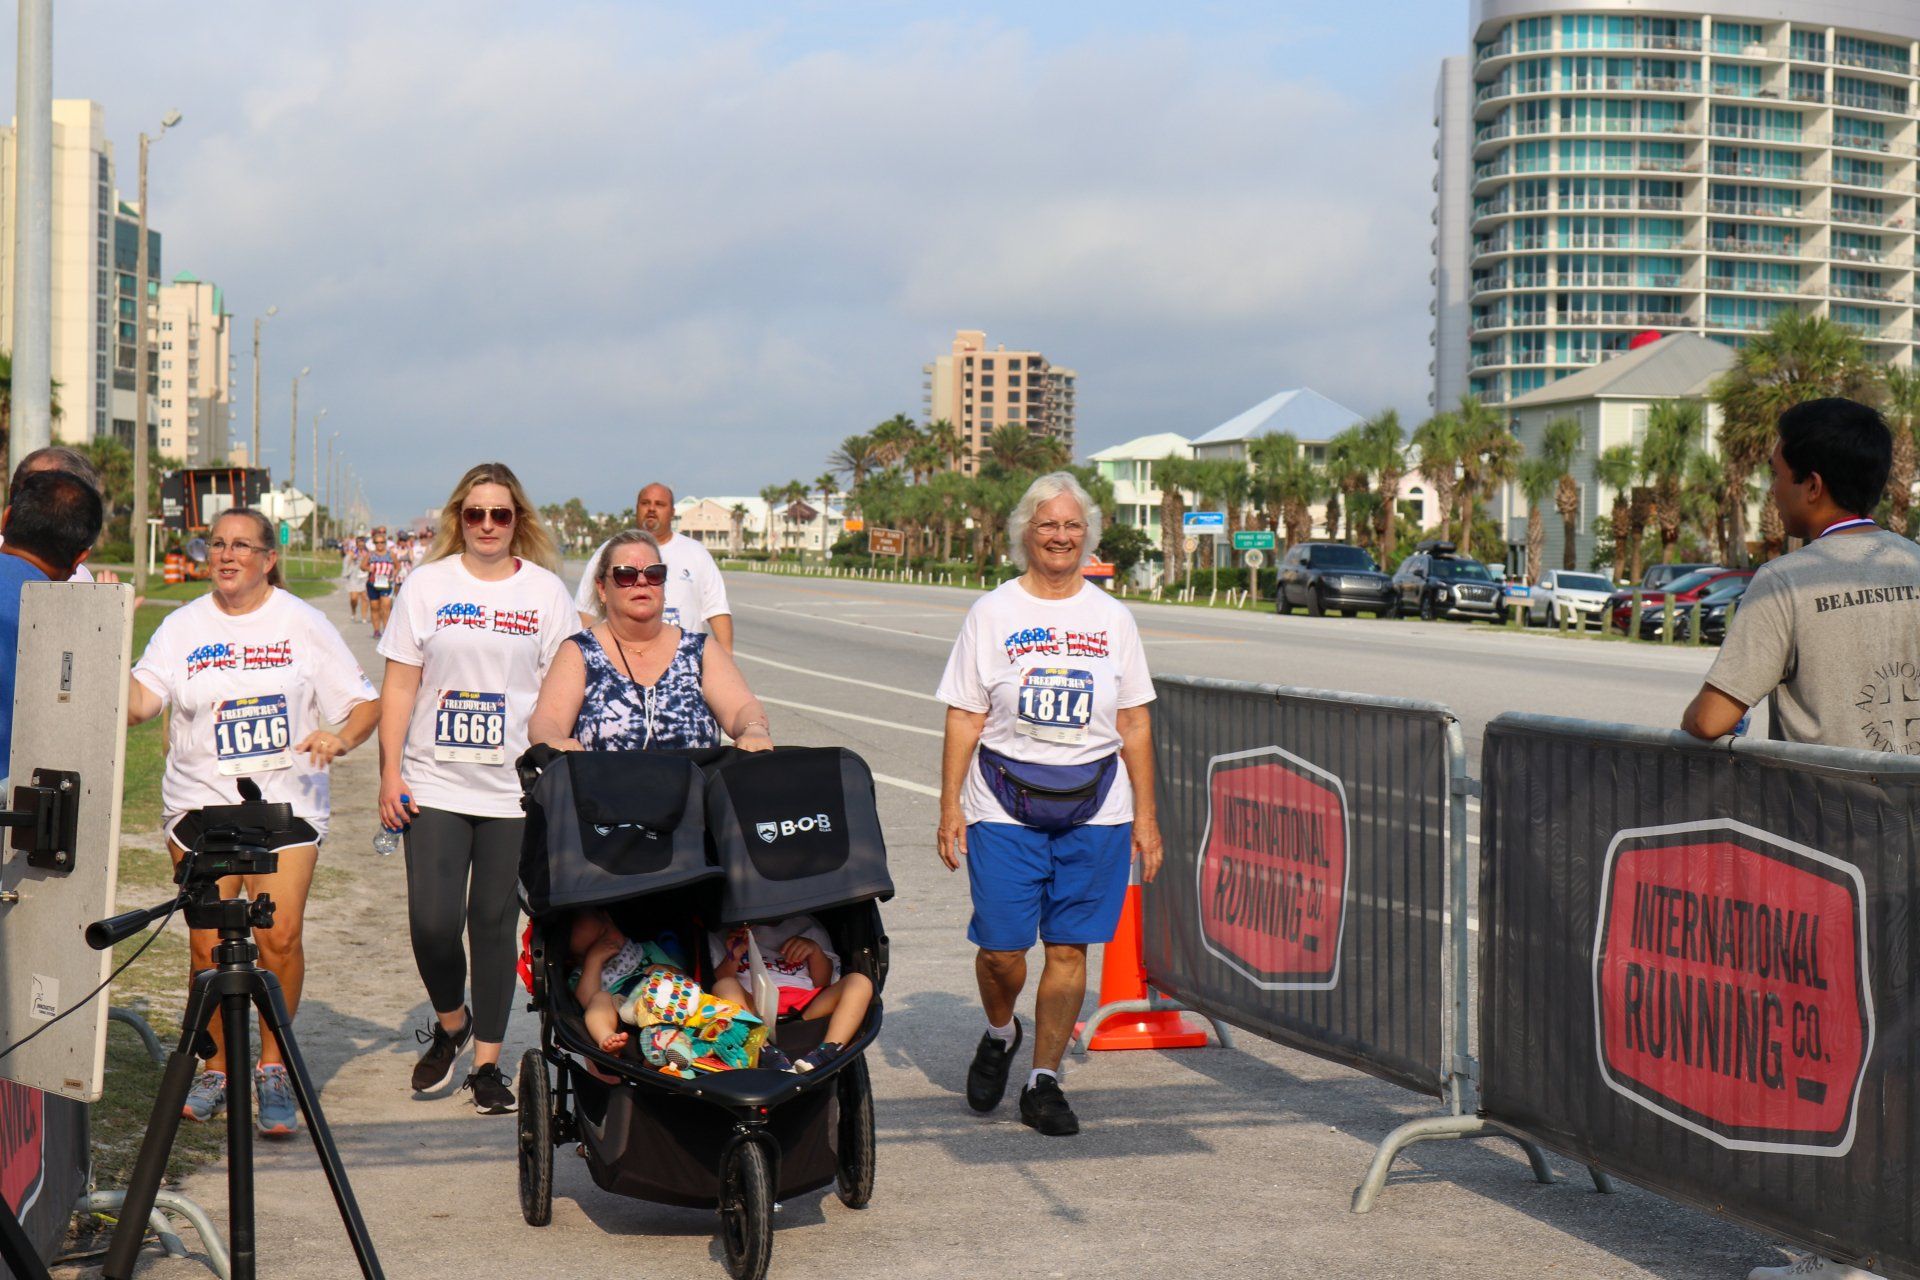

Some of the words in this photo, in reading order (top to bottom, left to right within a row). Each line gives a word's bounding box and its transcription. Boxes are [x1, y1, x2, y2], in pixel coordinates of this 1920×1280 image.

[217, 716, 288, 756] 1646
[438, 712, 503, 745] 1668
[1022, 687, 1090, 724] 1814
[1223, 795, 1330, 869] INTERNATIONAL
[1213, 855, 1304, 944] RUNNING
[1306, 877, 1325, 923] CO.
[1630, 881, 1828, 991] INTERNATIONAL
[1624, 962, 1786, 1090] RUNNING
[1791, 1001, 1831, 1064] CO.
